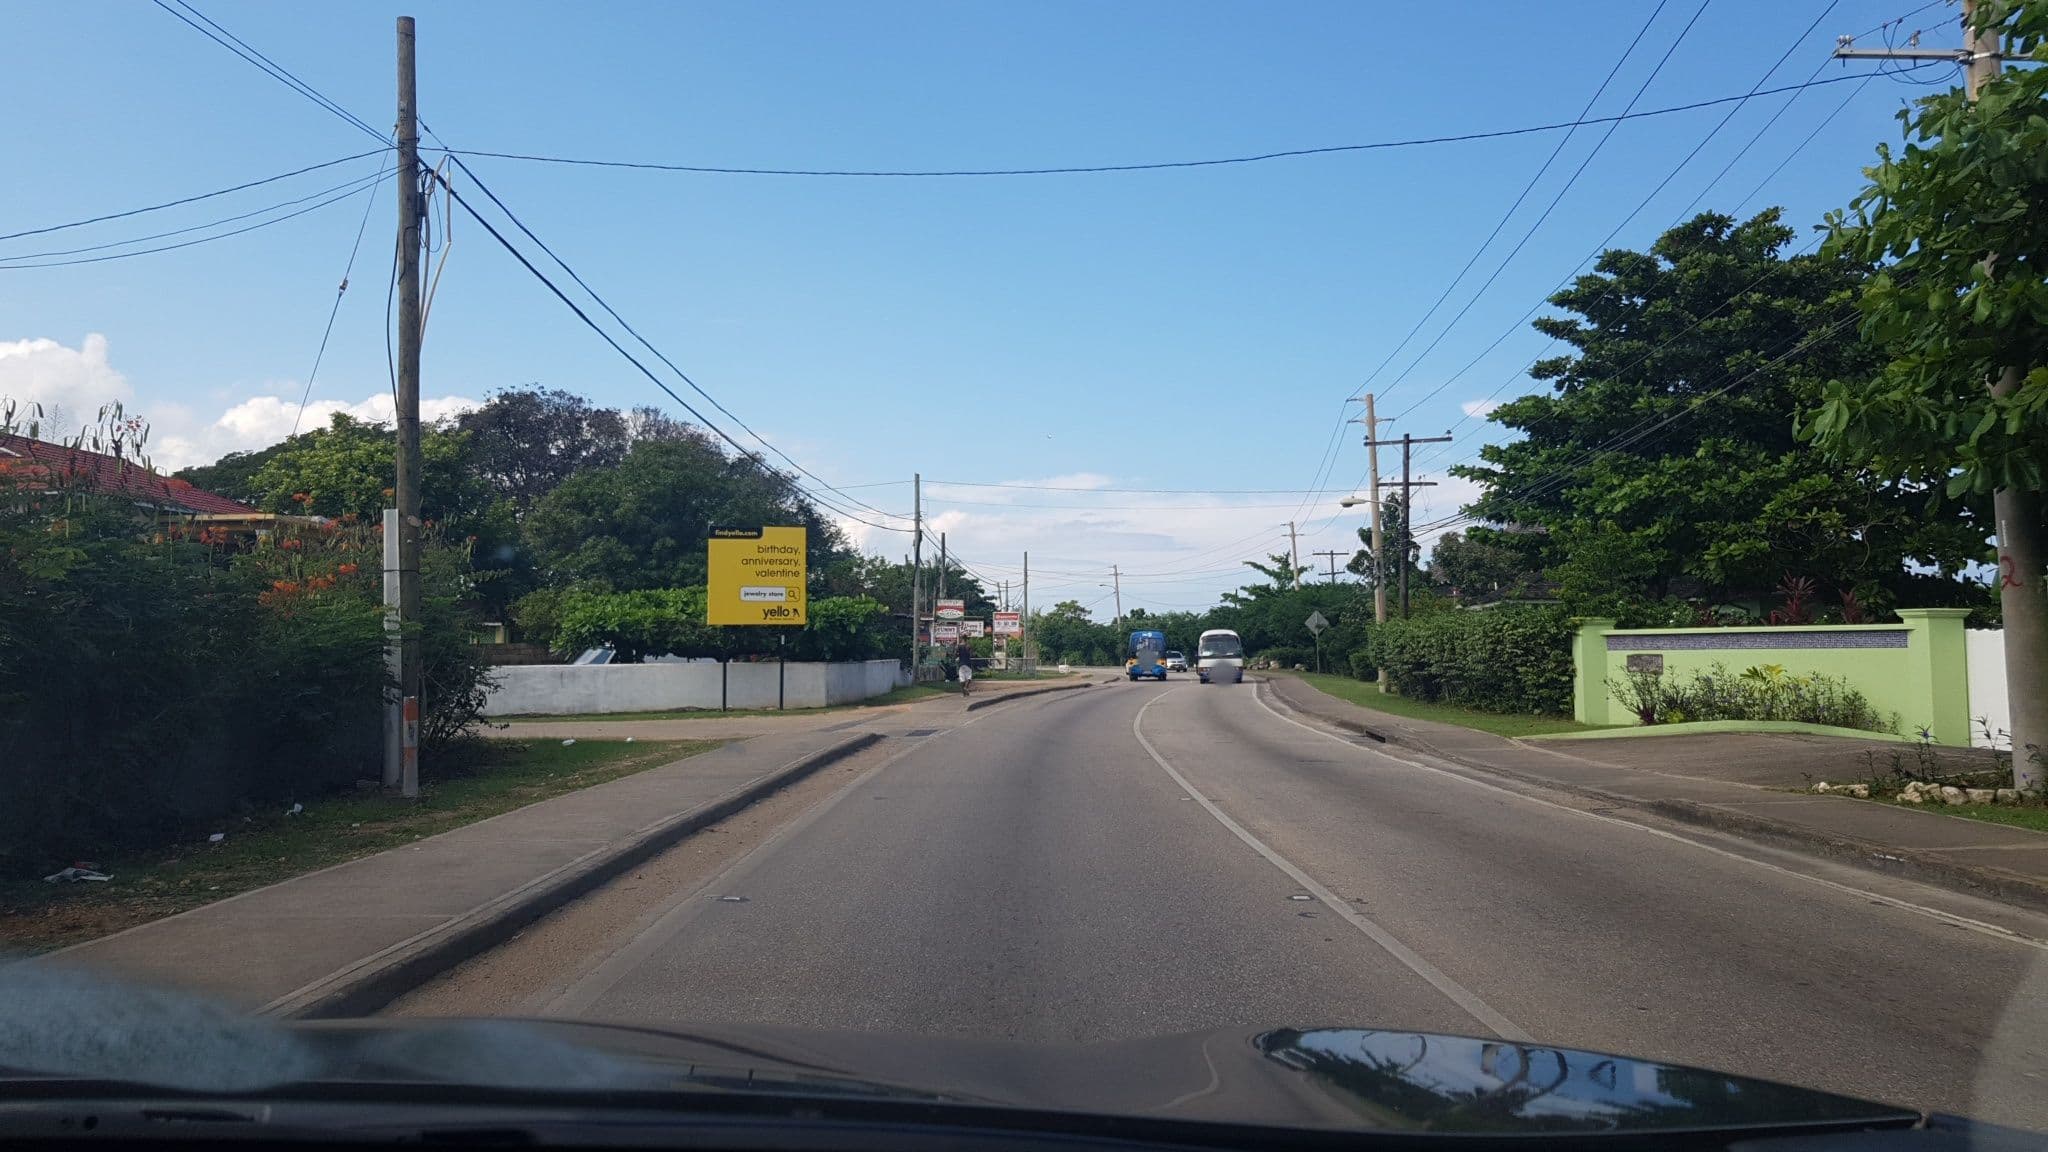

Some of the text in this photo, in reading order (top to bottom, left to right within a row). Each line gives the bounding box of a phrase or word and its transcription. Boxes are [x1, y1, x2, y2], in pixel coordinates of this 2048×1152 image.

[715, 529, 758, 537] findyello.com
[755, 568, 800, 578] valentine
[743, 590, 767, 598] jewelry
[762, 605, 790, 620] yello
